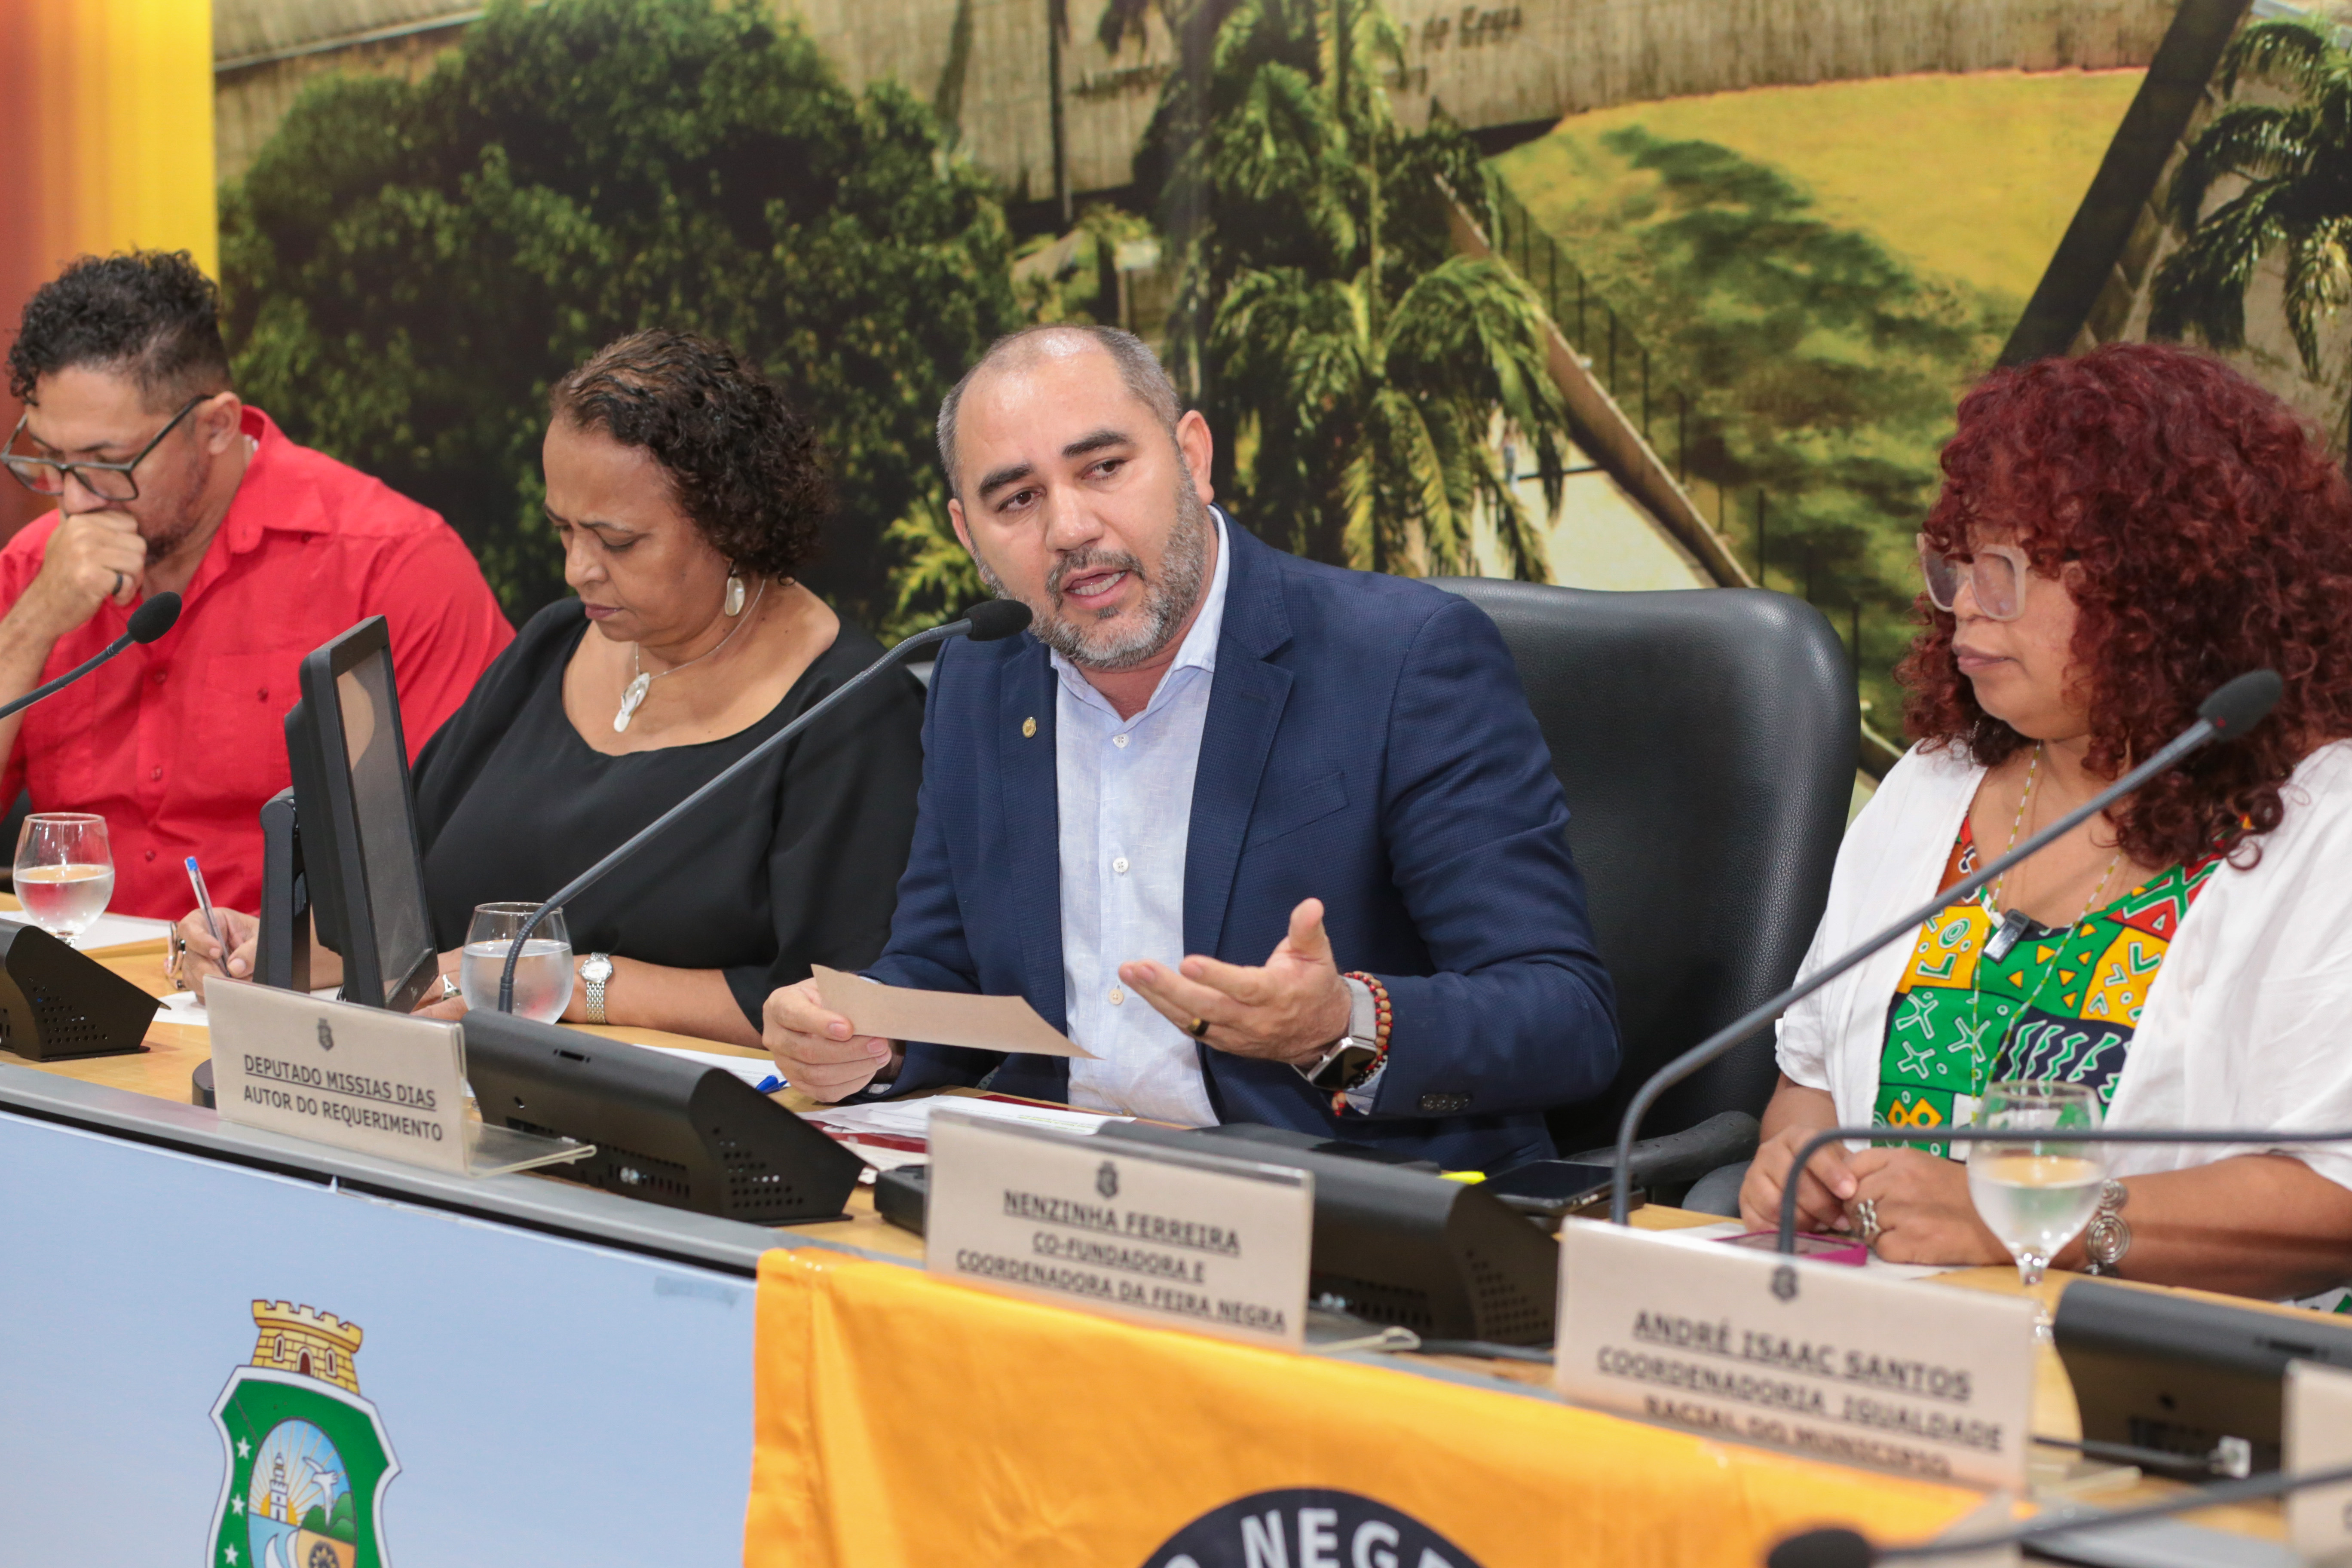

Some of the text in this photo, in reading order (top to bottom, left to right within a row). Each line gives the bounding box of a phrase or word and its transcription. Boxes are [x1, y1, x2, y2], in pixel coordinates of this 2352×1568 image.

[244, 1054, 436, 1108] DEPUTADO MISSIAS DIAS
[244, 1085, 443, 1141] AUTOR DO REQUERIMENTO
[1004, 1189, 1240, 1252] NENZINHA FERREIRA
[1033, 1231, 1206, 1283] CO-FUNDADORA E
[956, 1249, 1288, 1332] COORDENADORA DA FEIRA NEGRA
[1634, 1310, 1972, 1403] ANDRÉ ISAAC SANTOS
[1597, 1345, 2002, 1452] COORDENADORIA IGUALDADE
